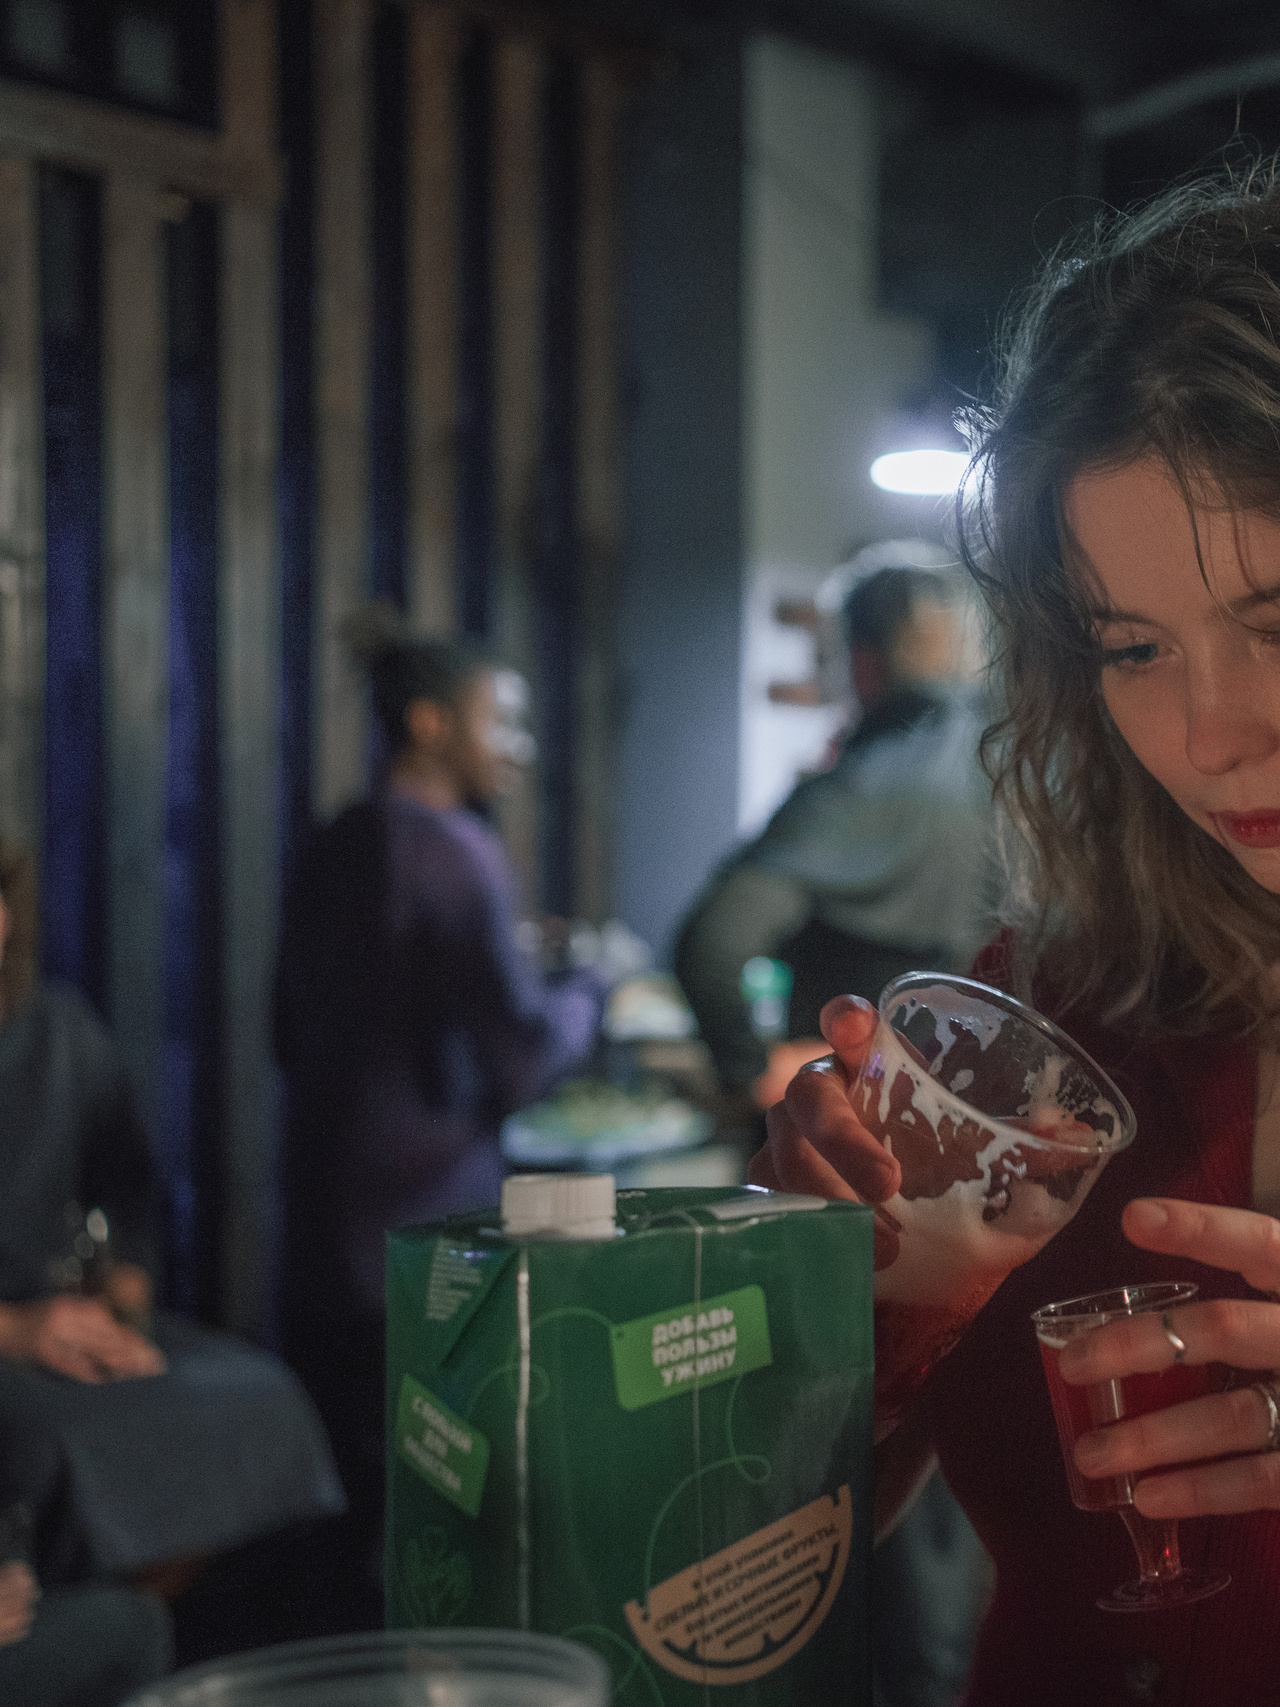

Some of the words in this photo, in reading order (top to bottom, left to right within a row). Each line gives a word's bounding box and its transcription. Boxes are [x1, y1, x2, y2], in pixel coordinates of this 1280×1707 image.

[652, 1307, 734, 1346] ДОБАВЬ
[652, 1326, 737, 1366] ПОЛЬЗЫ
[661, 1349, 735, 1387] УЖИНУ
